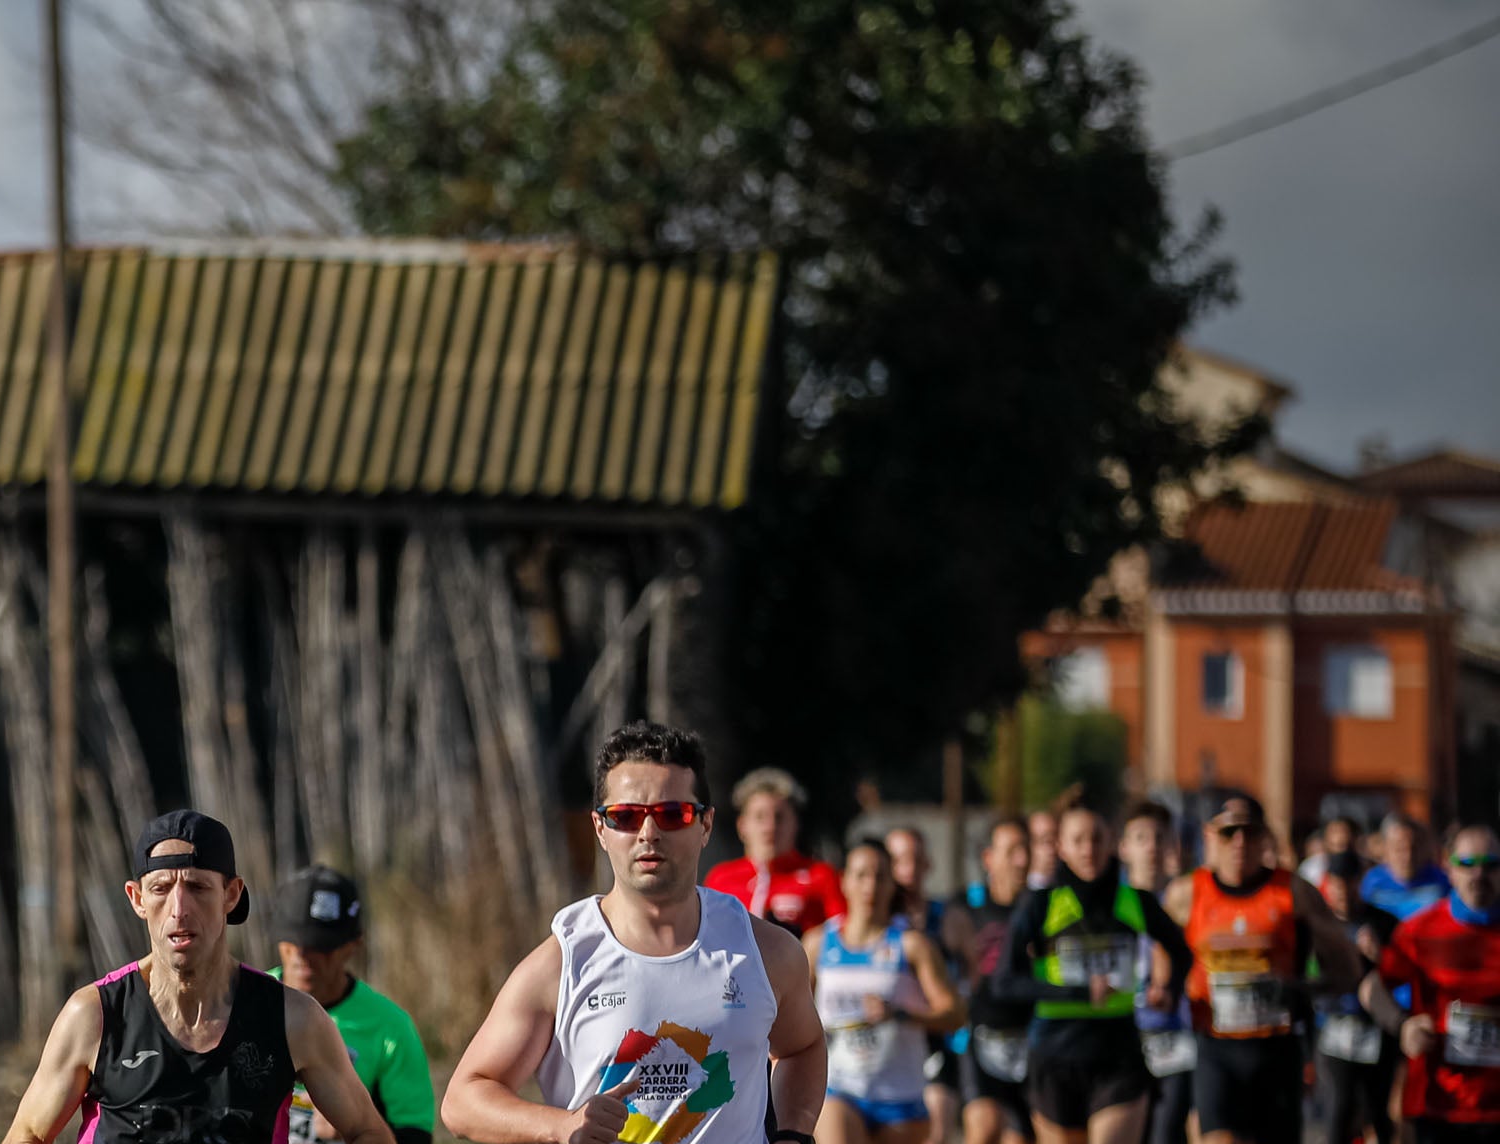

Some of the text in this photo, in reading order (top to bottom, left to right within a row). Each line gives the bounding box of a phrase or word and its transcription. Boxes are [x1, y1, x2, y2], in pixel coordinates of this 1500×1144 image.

[639, 1063, 688, 1075] XXVIII
[639, 1076, 687, 1085] CARRERA
[637, 1086, 687, 1094] DE FONDO
